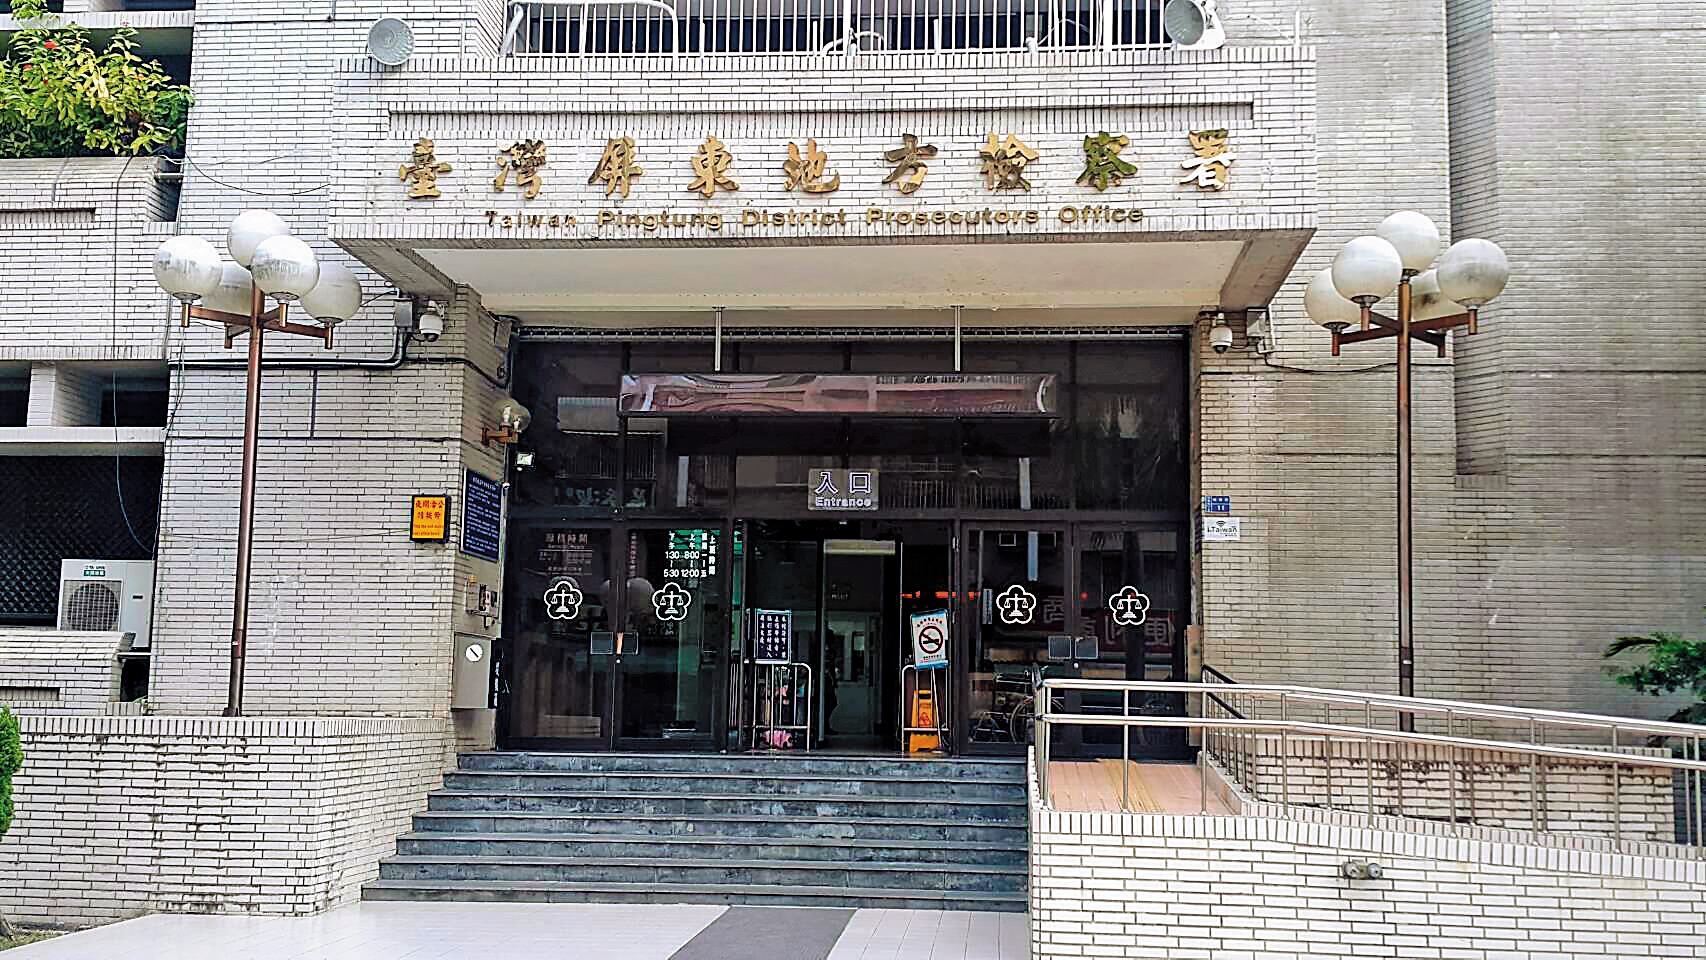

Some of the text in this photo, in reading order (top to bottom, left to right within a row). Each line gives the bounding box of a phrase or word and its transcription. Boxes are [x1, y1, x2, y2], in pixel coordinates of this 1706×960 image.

[399, 129, 1237, 199] 臺灣屏東地方檢察署
[486, 205, 1143, 231] Taiwan Pingtung District Prosecutors Office
[816, 470, 872, 495] 入口
[815, 496, 872, 508] Entrance
